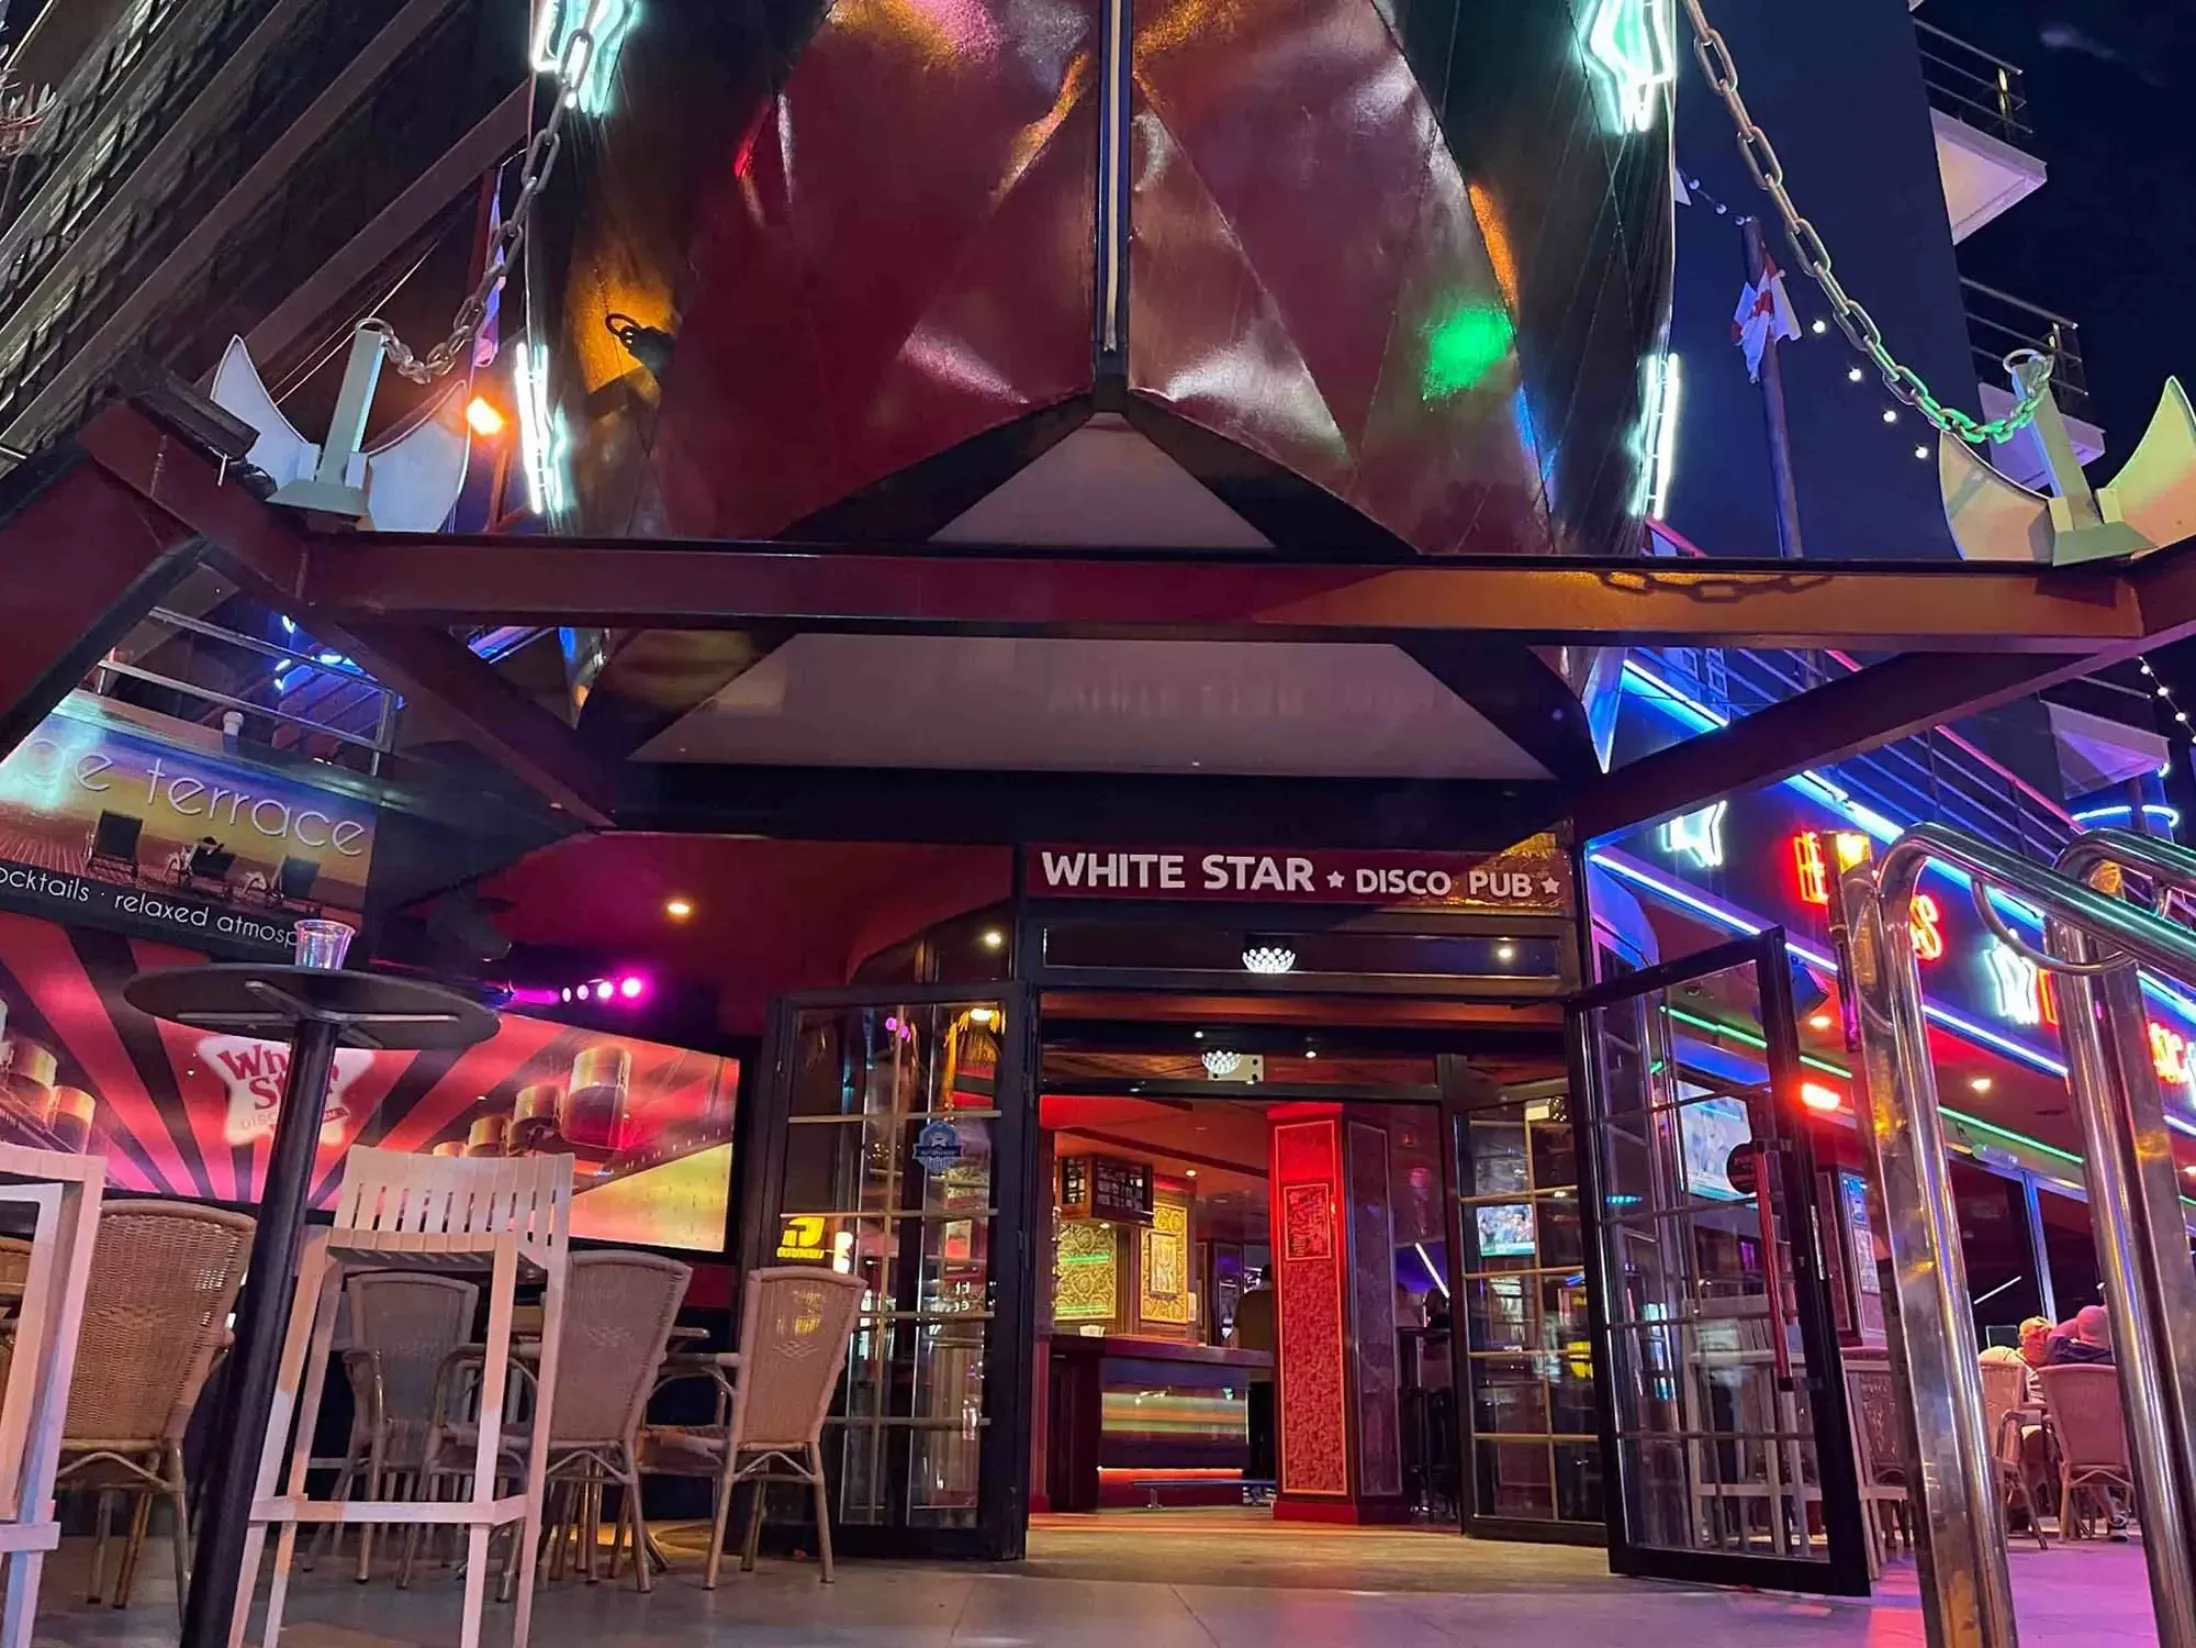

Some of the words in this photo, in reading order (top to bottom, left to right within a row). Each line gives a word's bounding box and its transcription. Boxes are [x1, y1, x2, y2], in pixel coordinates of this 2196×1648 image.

[145, 757, 367, 856] terrace
[1042, 852, 1185, 889] WHITE
[1202, 854, 1315, 892] STAR
[1357, 868, 1451, 896] DISCO
[1469, 870, 1532, 897] PUB
[114, 891, 209, 926] relaxed
